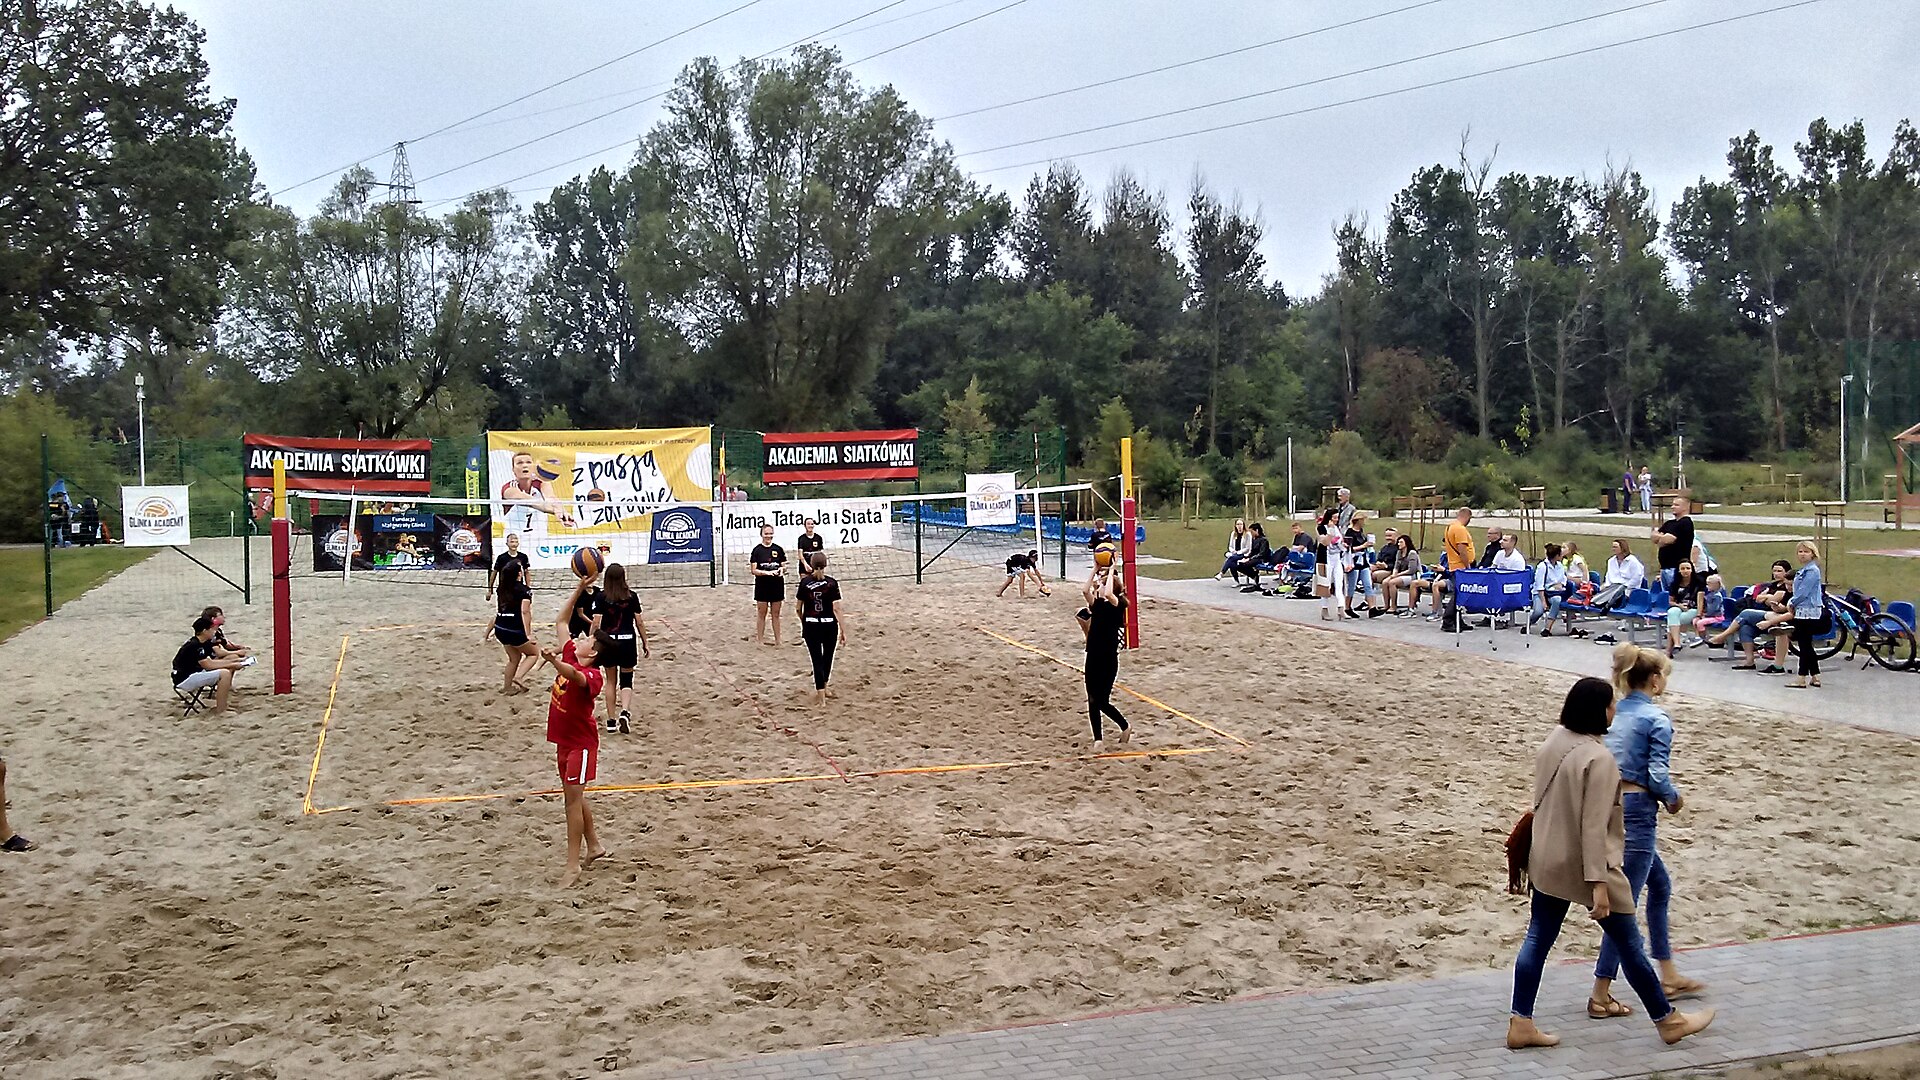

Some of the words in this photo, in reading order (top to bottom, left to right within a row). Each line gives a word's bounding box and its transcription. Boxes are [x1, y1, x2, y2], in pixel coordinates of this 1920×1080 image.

[566, 439, 586, 447] KTÓRA
[250, 449, 334, 472] AKADEMIA
[341, 451, 425, 474] SIATKÓWKI
[768, 446, 838, 466] AKADEMIA
[843, 441, 914, 463] SIATKÓWKI
[589, 450, 658, 492] pasją
[129, 516, 152, 528] GLINKA
[154, 516, 184, 528] ACADEMY
[813, 509, 831, 525] Ja
[840, 527, 860, 544] 20
[1460, 583, 1488, 594] molten
